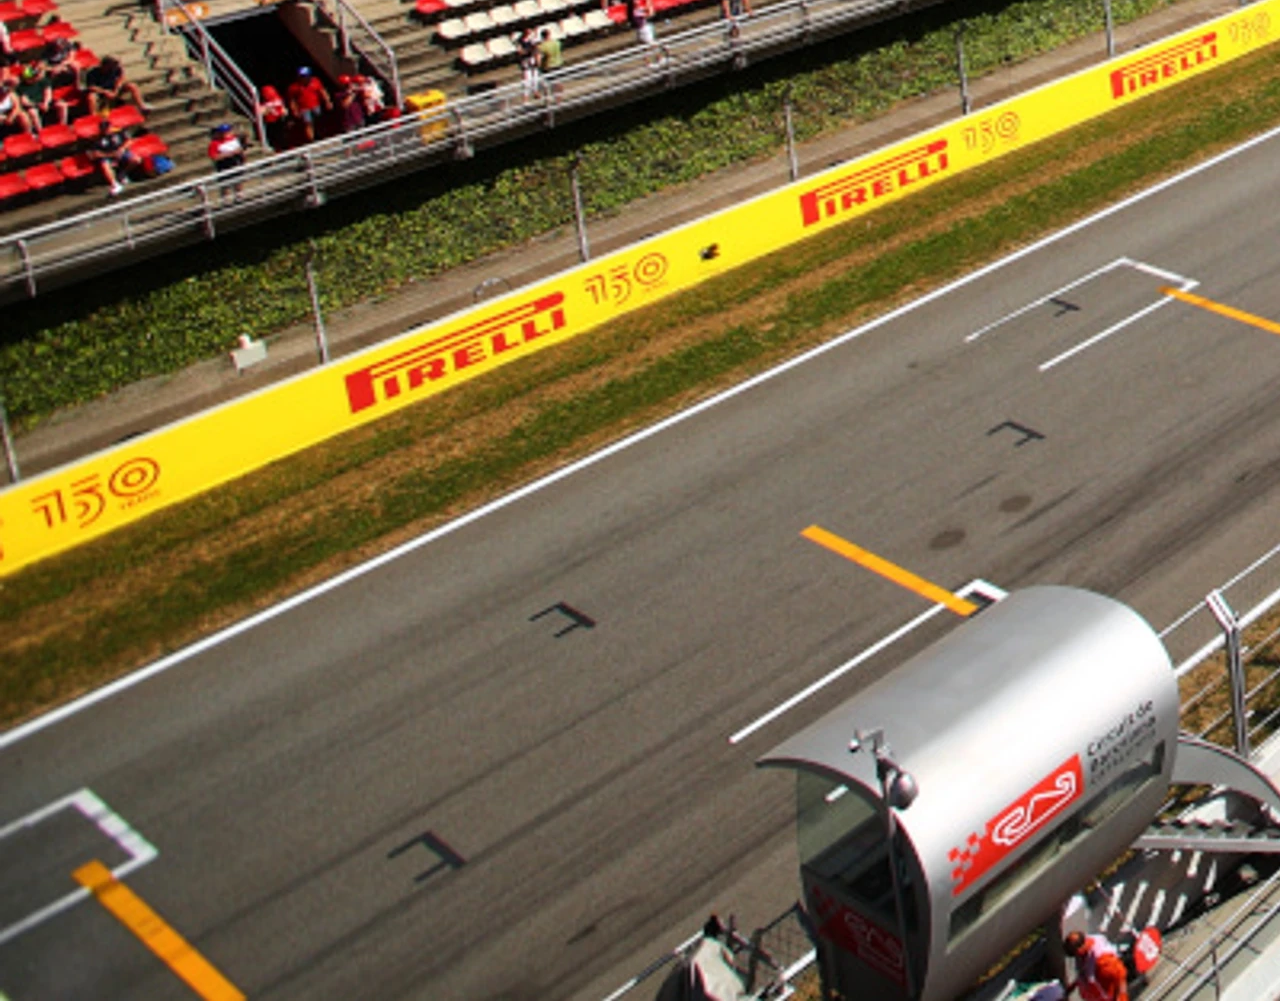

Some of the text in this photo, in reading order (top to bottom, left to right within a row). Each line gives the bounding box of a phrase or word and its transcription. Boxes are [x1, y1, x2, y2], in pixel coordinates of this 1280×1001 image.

[1110, 31, 1217, 99] PIRELLI
[799, 139, 949, 227] PIRELLI
[344, 290, 567, 415] PIRELLI
[31, 457, 161, 529] 150
